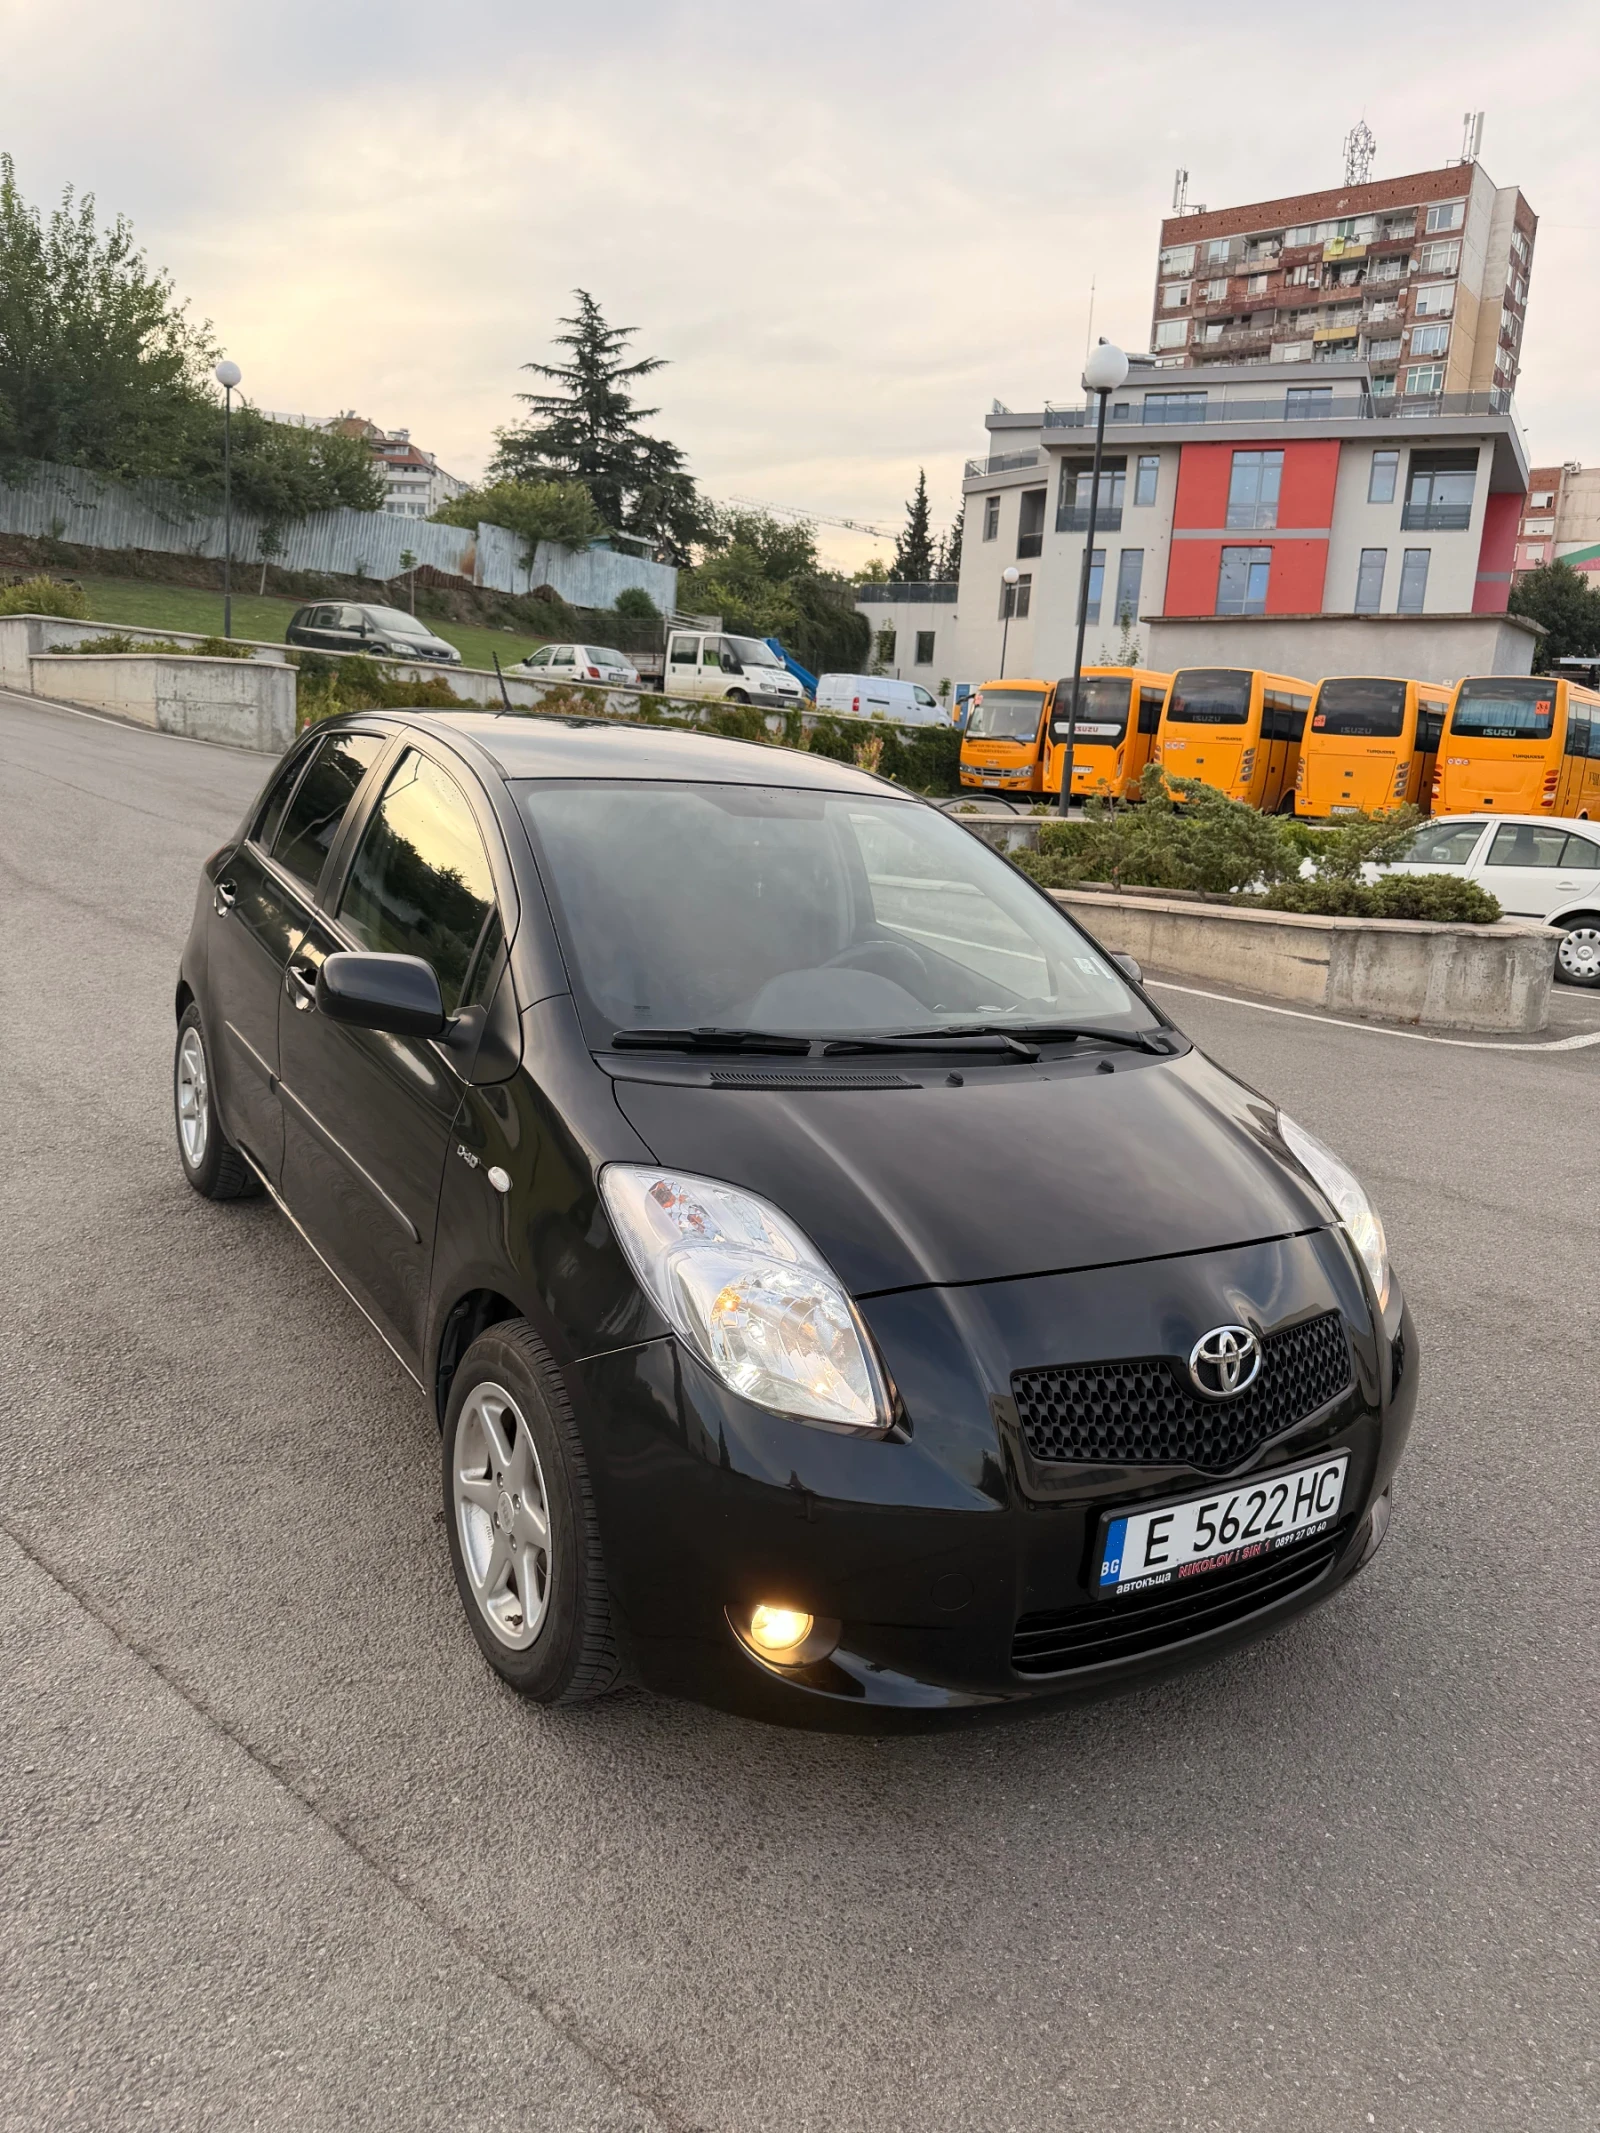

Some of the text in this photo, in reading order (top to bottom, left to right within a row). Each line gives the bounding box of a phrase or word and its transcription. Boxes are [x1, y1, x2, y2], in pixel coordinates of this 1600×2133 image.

[1192, 715, 1221, 723] ISUZU
[1340, 726, 1373, 735] ISUZU
[1482, 728, 1517, 737] ISUZU
[1143, 1466, 1340, 1567] E 5622 HC
[1116, 1572, 1172, 1595] автокъща
[1178, 1551, 1234, 1579] NIKOLOV
[1242, 1542, 1262, 1560] SIN
[1275, 1534, 1294, 1548] 0899
[1295, 1528, 1306, 1541] 27
[1306, 1525, 1316, 1537] 00
[1317, 1521, 1327, 1532] 60
[1100, 1559, 1120, 1577] BG
